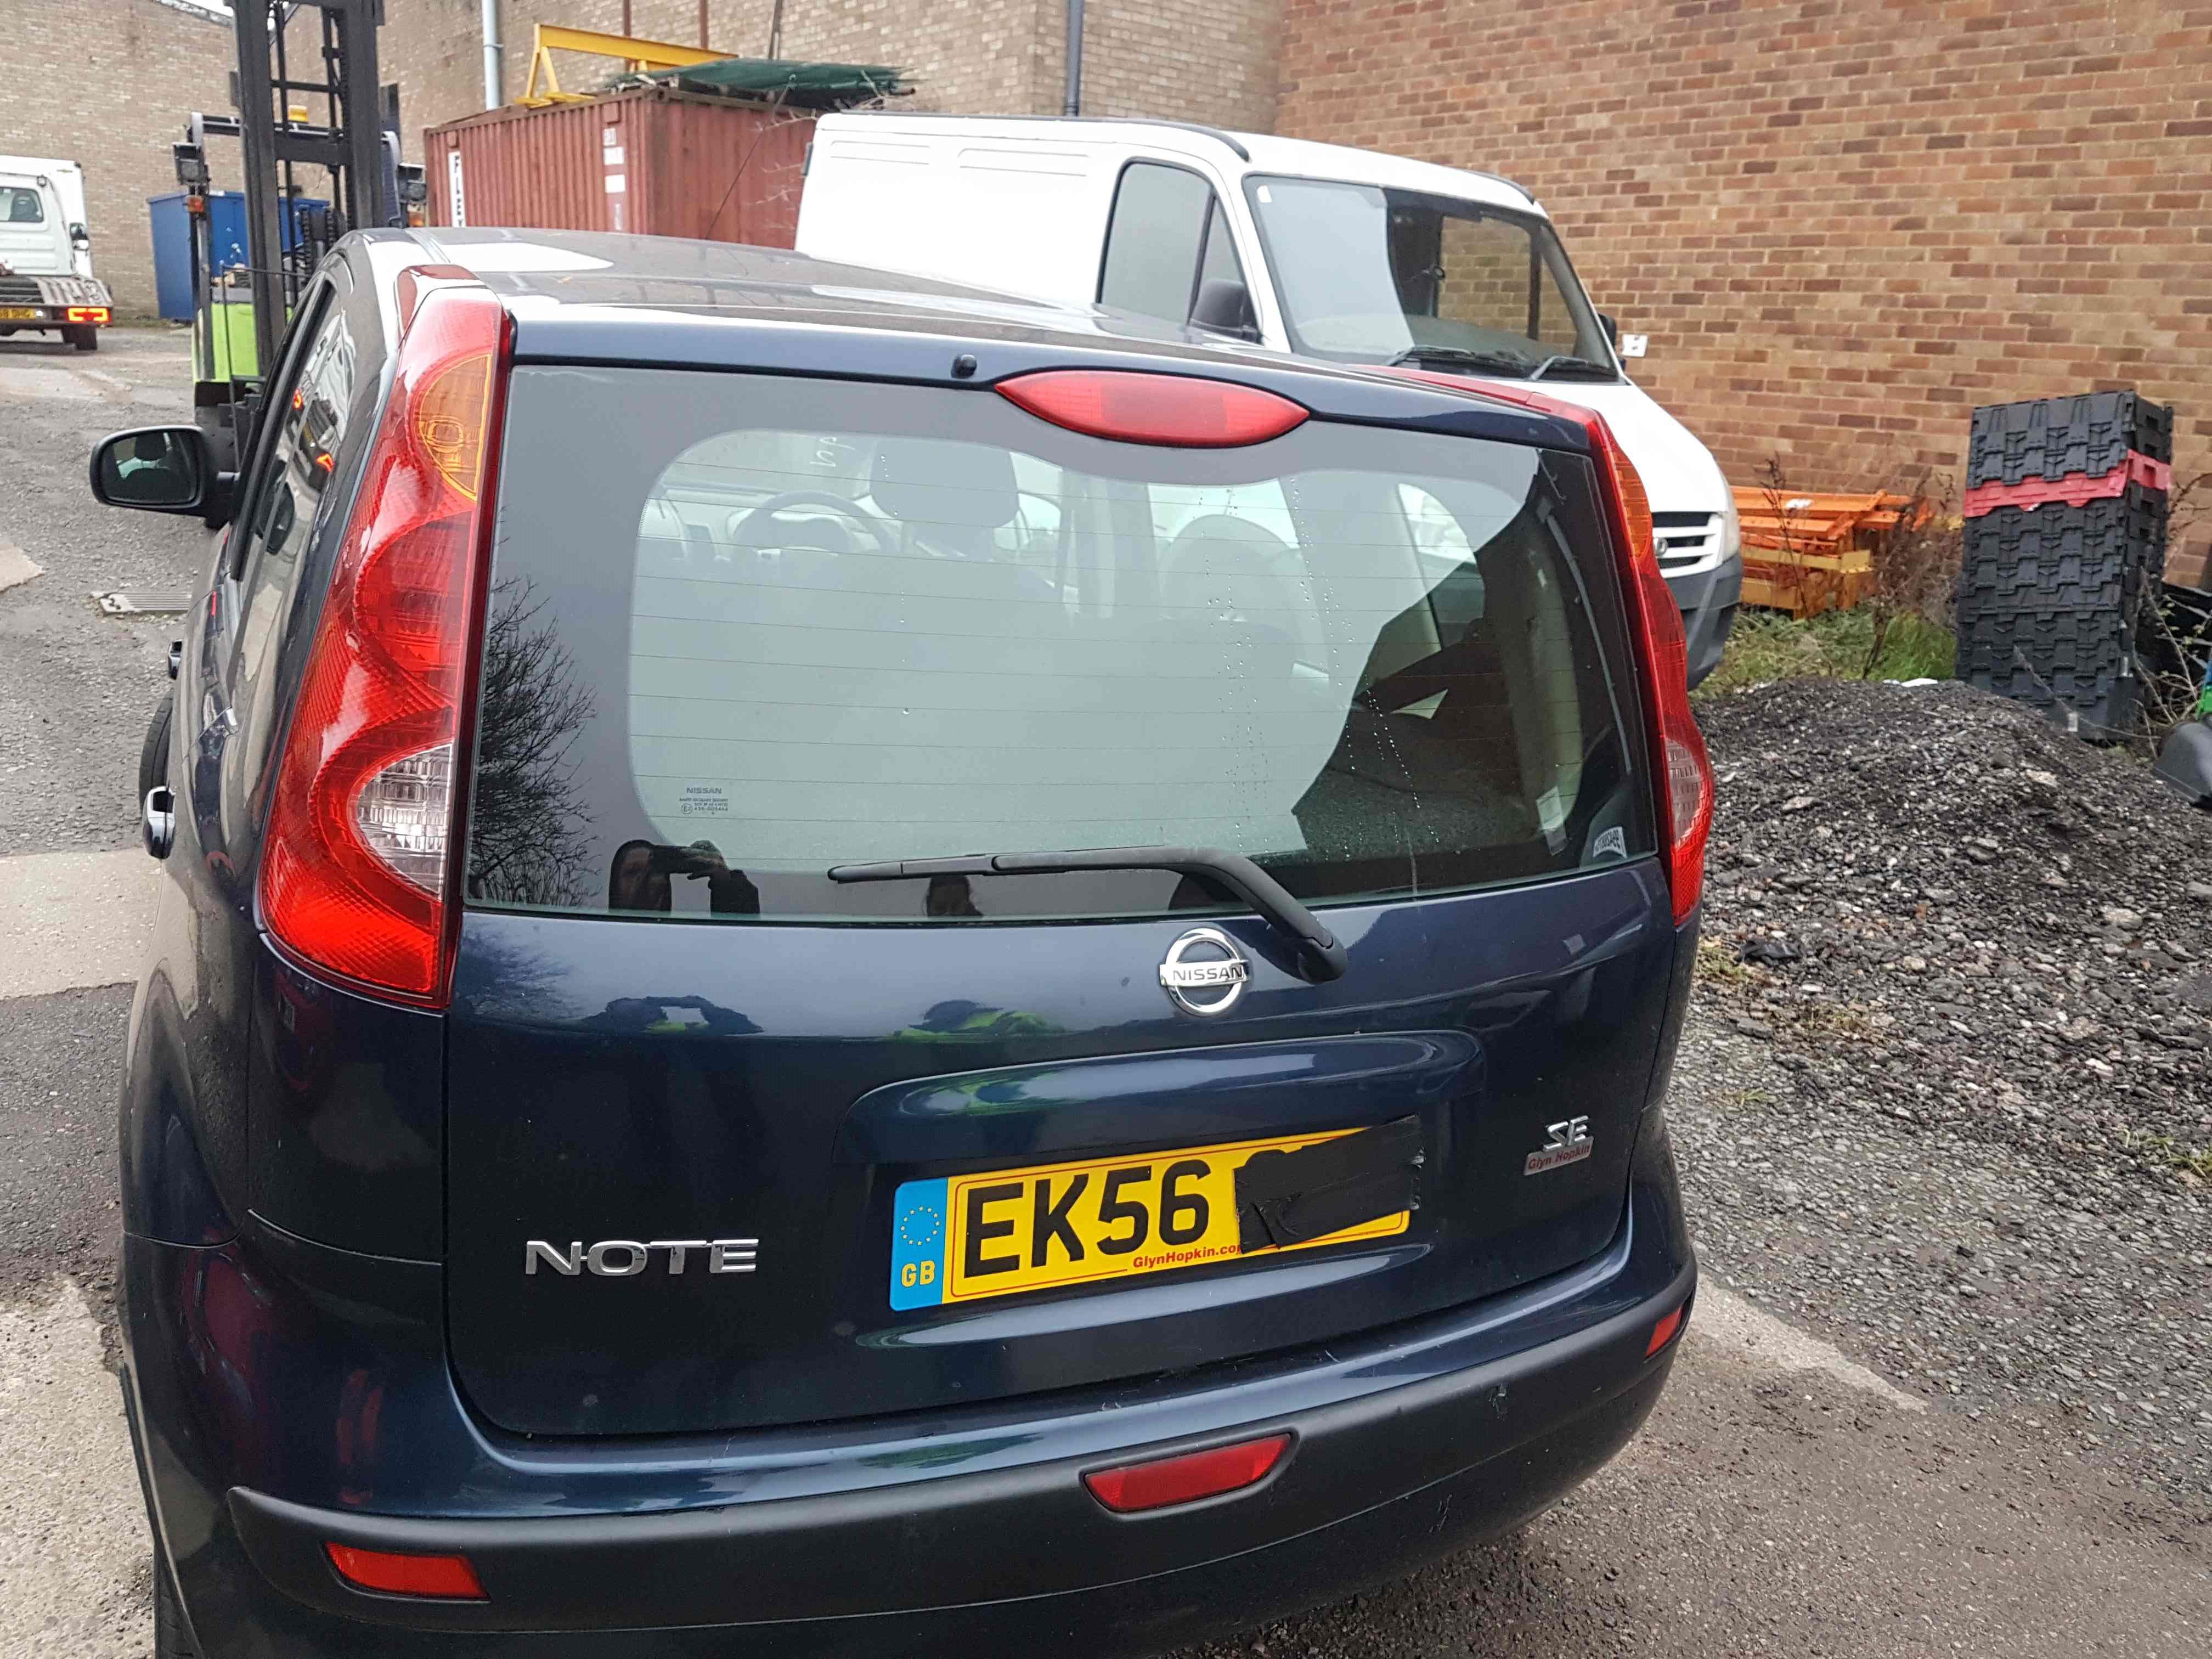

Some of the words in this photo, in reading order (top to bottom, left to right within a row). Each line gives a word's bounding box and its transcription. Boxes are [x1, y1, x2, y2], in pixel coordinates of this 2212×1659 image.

[1173, 967, 1243, 981] NISSAN
[1542, 1115, 1589, 1152] SE
[1528, 1156, 1551, 1170] Glyn
[1555, 1145, 1590, 1162] Hopkin
[964, 1159, 1211, 1278] EK56
[526, 1238, 759, 1276] NOTE
[901, 1260, 935, 1287] GB
